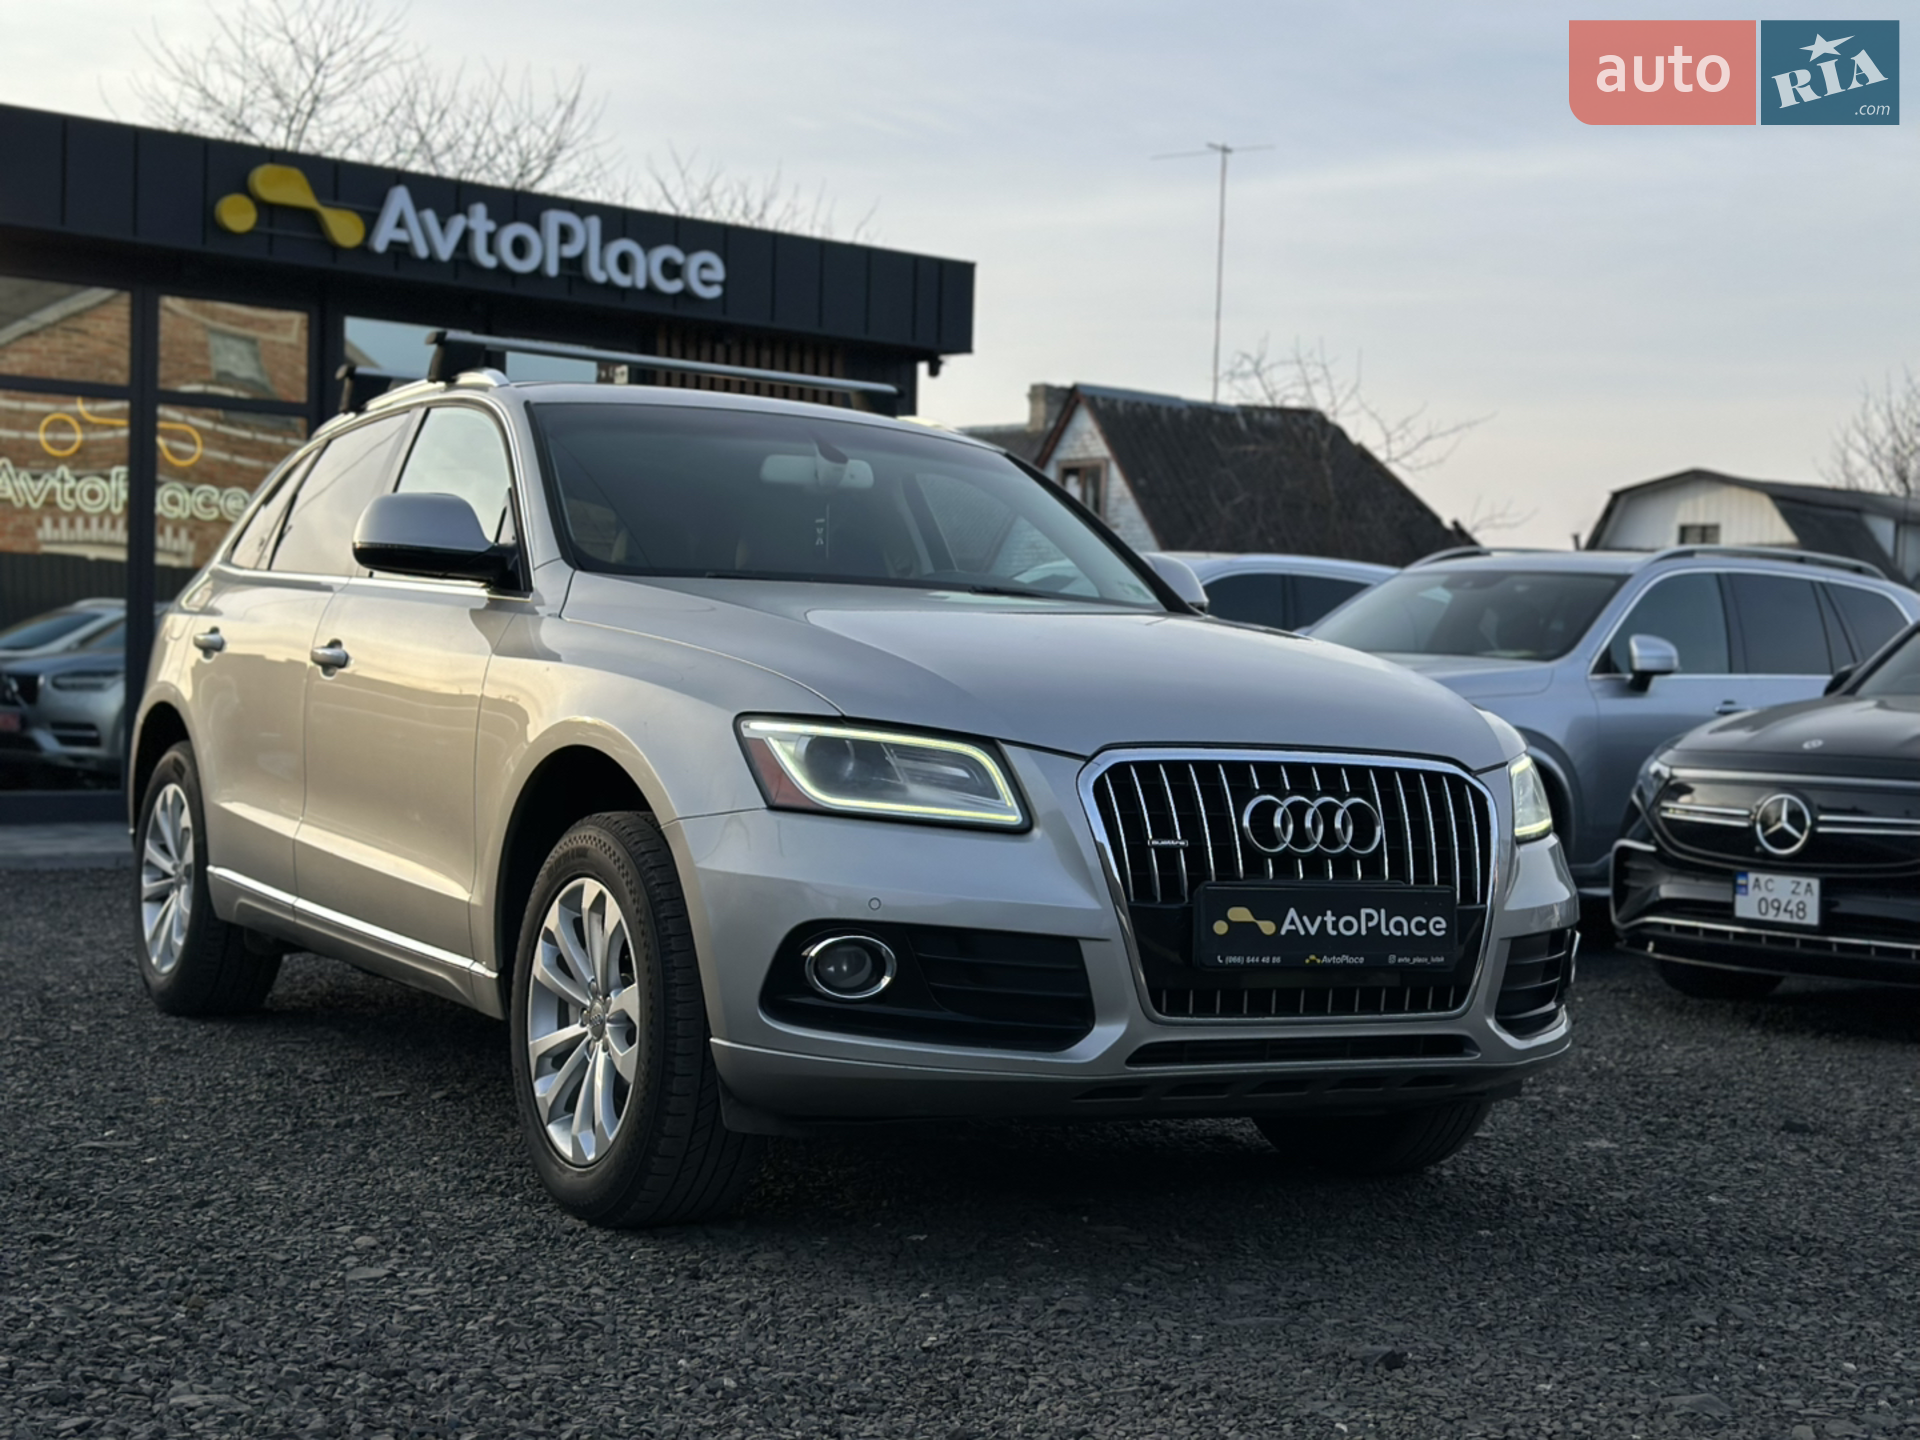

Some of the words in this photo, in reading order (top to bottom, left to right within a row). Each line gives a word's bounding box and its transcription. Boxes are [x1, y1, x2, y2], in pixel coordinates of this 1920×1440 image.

[368, 184, 726, 300] AvtoPlace
[0, 457, 250, 522] AvtoPace
[1752, 877, 1775, 893] AC
[1790, 880, 1814, 897] ZA
[1280, 907, 1448, 936] AvtoPlace
[1757, 897, 1807, 920] 0948
[1321, 954, 1365, 964] AvtoPlace
